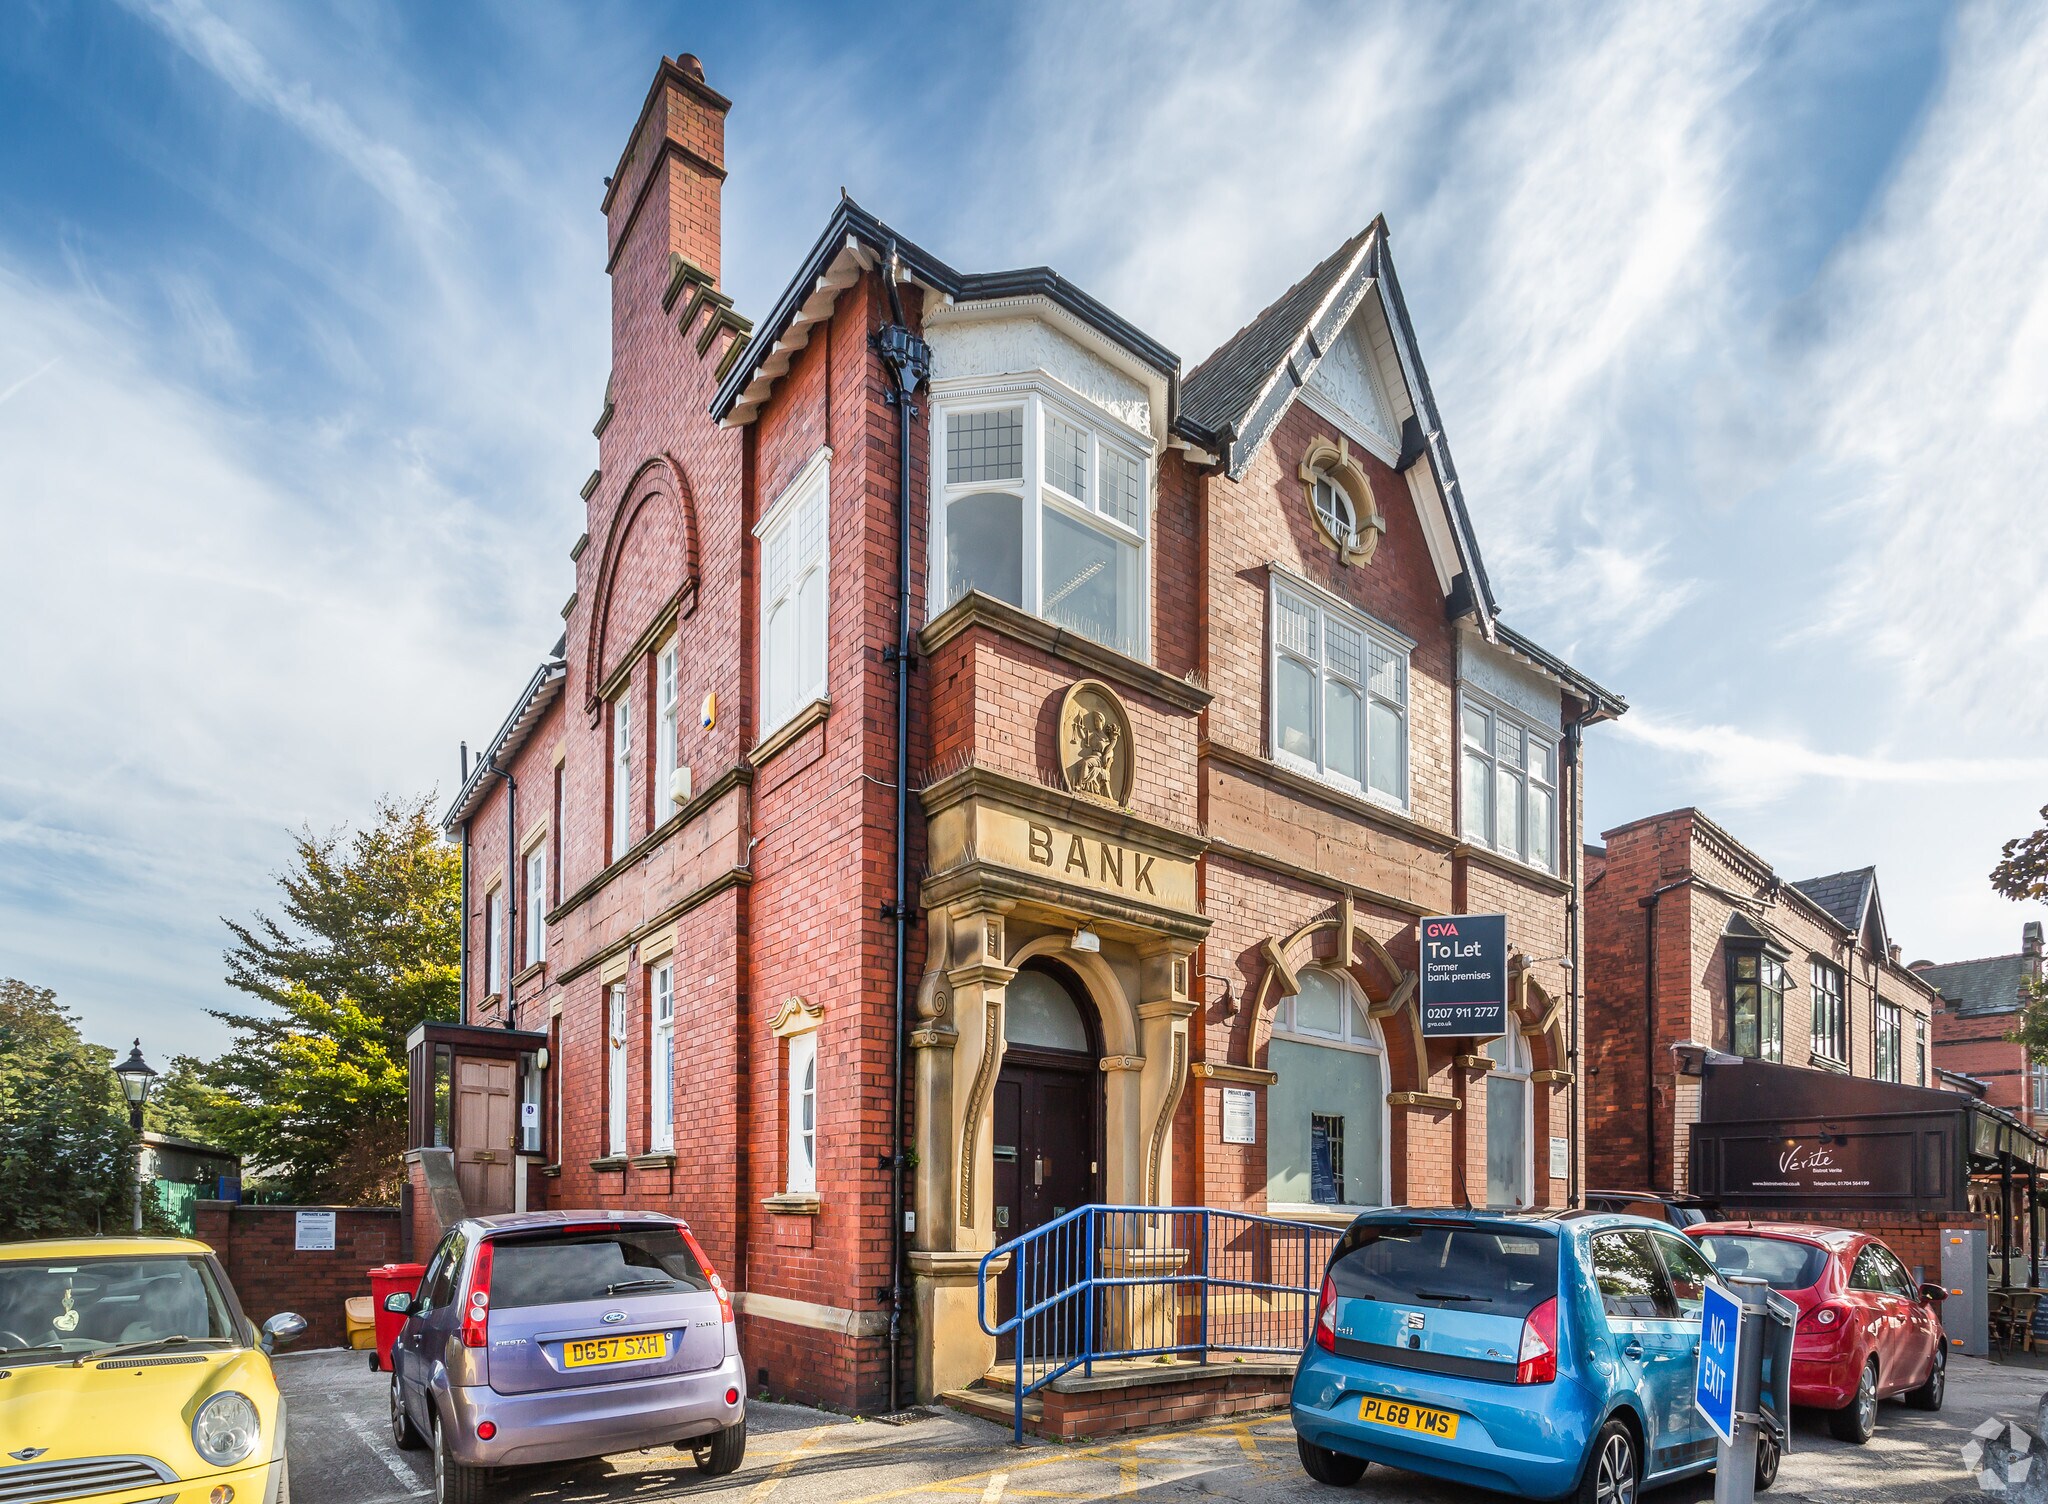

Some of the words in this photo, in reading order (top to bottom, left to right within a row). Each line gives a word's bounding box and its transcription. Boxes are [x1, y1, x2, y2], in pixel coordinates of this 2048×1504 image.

[1028, 820, 1156, 896] BANK
[1427, 923, 1459, 937] GVA
[1427, 942, 1451, 959] To
[1454, 941, 1482, 957] Let
[1427, 963, 1458, 972] Former
[1427, 972, 1450, 982] bank
[1452, 971, 1491, 983] premises
[1427, 1008, 1453, 1019] 0207
[1456, 1007, 1472, 1018] 911
[1474, 1006, 1500, 1018] 2727
[1427, 1020, 1452, 1028] gva.co.uk
[495, 1338, 527, 1346] FIESTA
[1710, 1313, 1726, 1355] NO
[625, 1335, 658, 1356] SXH
[1704, 1355, 1726, 1404] EXIT
[1364, 1400, 1410, 1425] PL68
[1415, 1409, 1450, 1434] YMS
